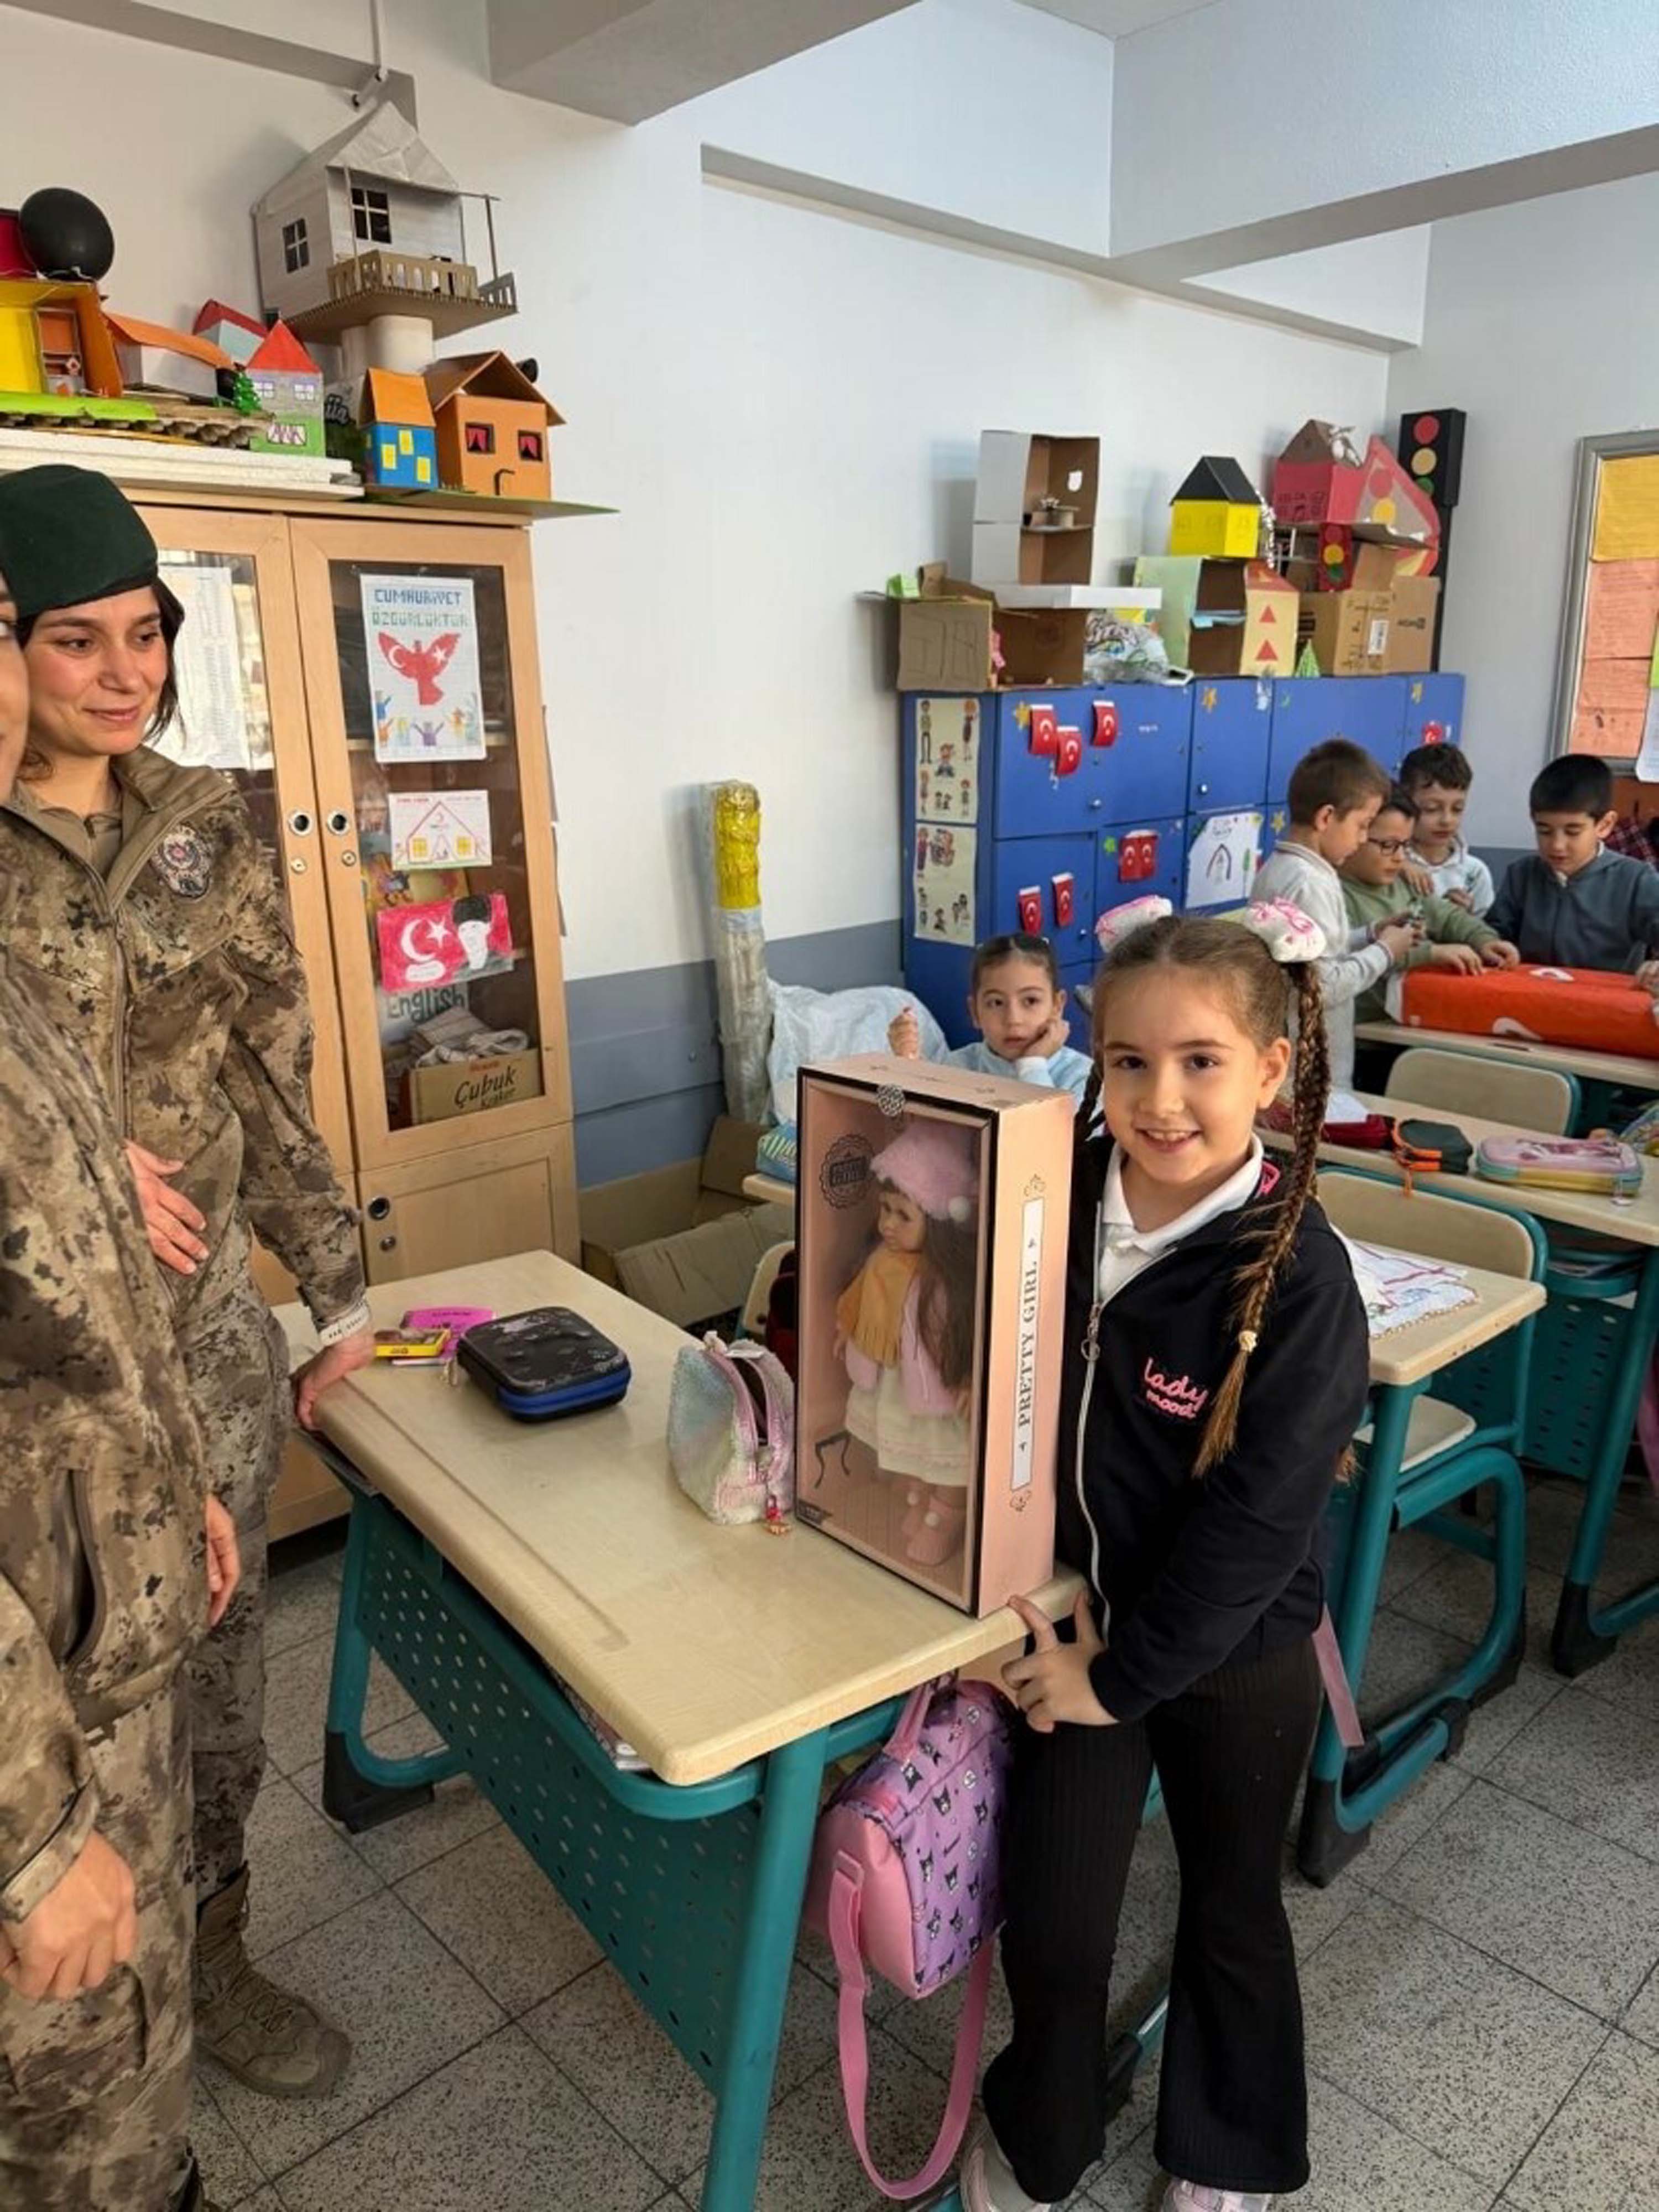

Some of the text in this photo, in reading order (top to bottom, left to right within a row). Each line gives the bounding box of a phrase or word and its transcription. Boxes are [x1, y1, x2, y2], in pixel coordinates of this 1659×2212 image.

[453, 1065, 517, 1109] Çubuk
[1018, 1261, 1037, 1428] PRETTY GIRL
